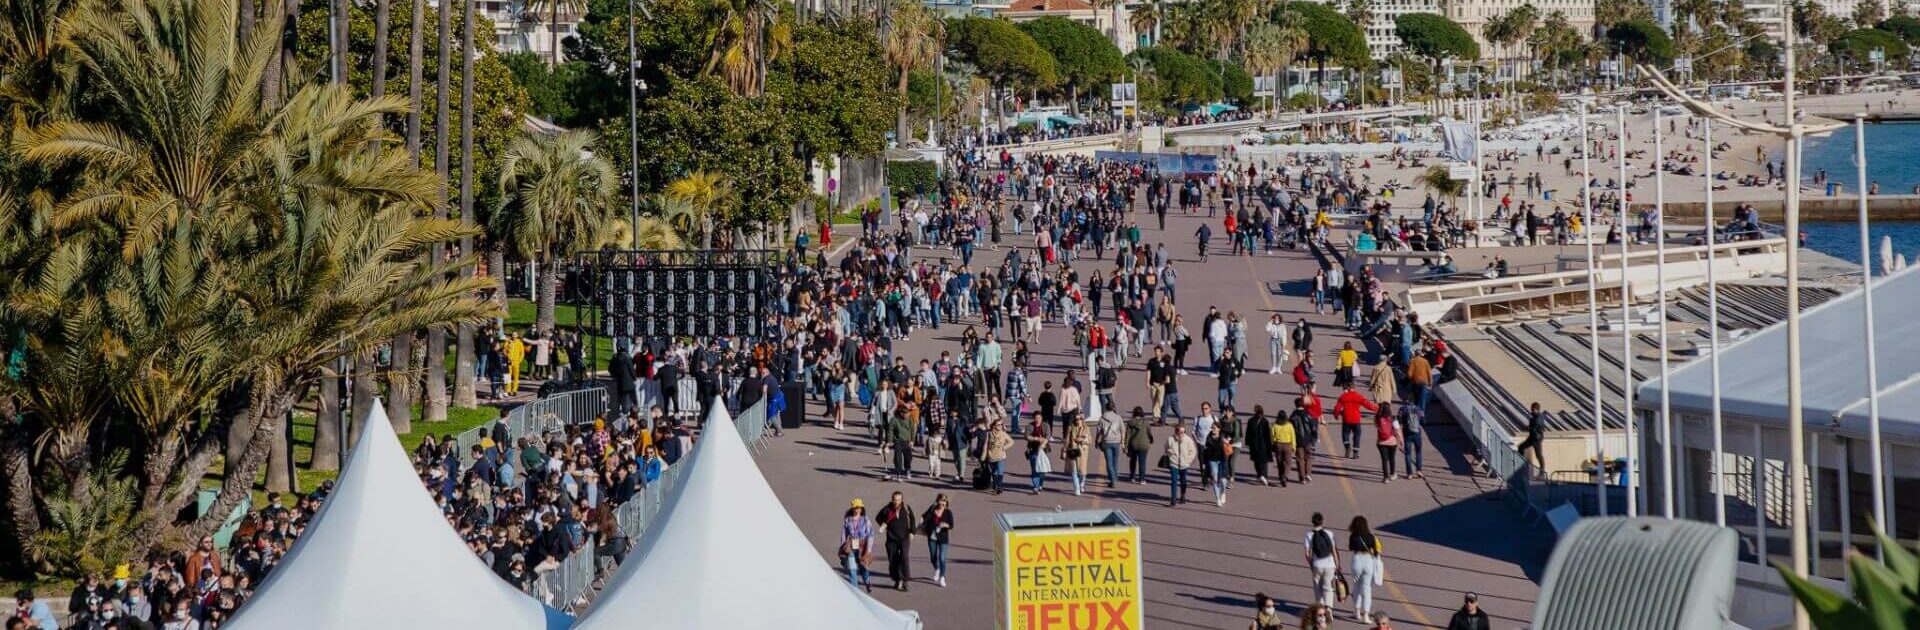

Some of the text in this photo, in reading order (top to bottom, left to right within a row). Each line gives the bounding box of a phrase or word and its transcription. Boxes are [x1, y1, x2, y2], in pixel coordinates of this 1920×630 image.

[1016, 539, 1131, 563] CANNES
[1017, 563, 1131, 587] FESTIVAL
[1018, 586, 1132, 601] INTERNATIONAL
